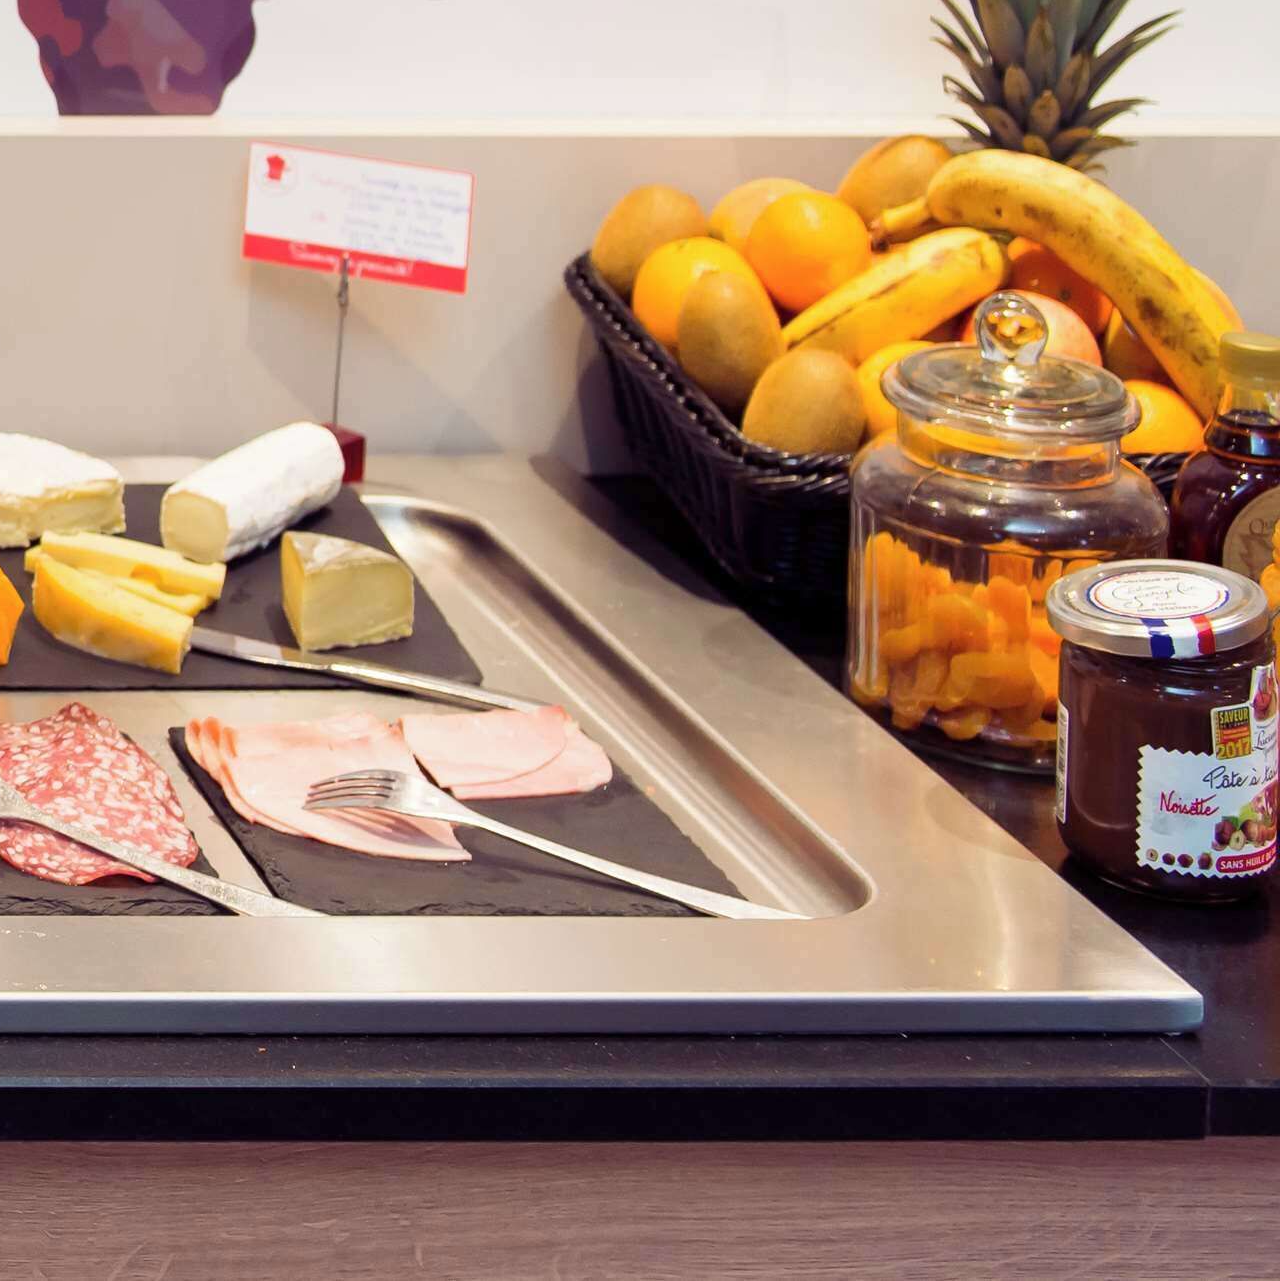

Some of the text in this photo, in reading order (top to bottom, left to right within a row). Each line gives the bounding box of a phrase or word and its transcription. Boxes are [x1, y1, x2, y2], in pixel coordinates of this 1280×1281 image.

[1220, 708, 1249, 724] SAVEUR
[1202, 765, 1249, 791] Pâte
[1159, 790, 1220, 817] Noisette
[1220, 860, 1244, 870] SANS
